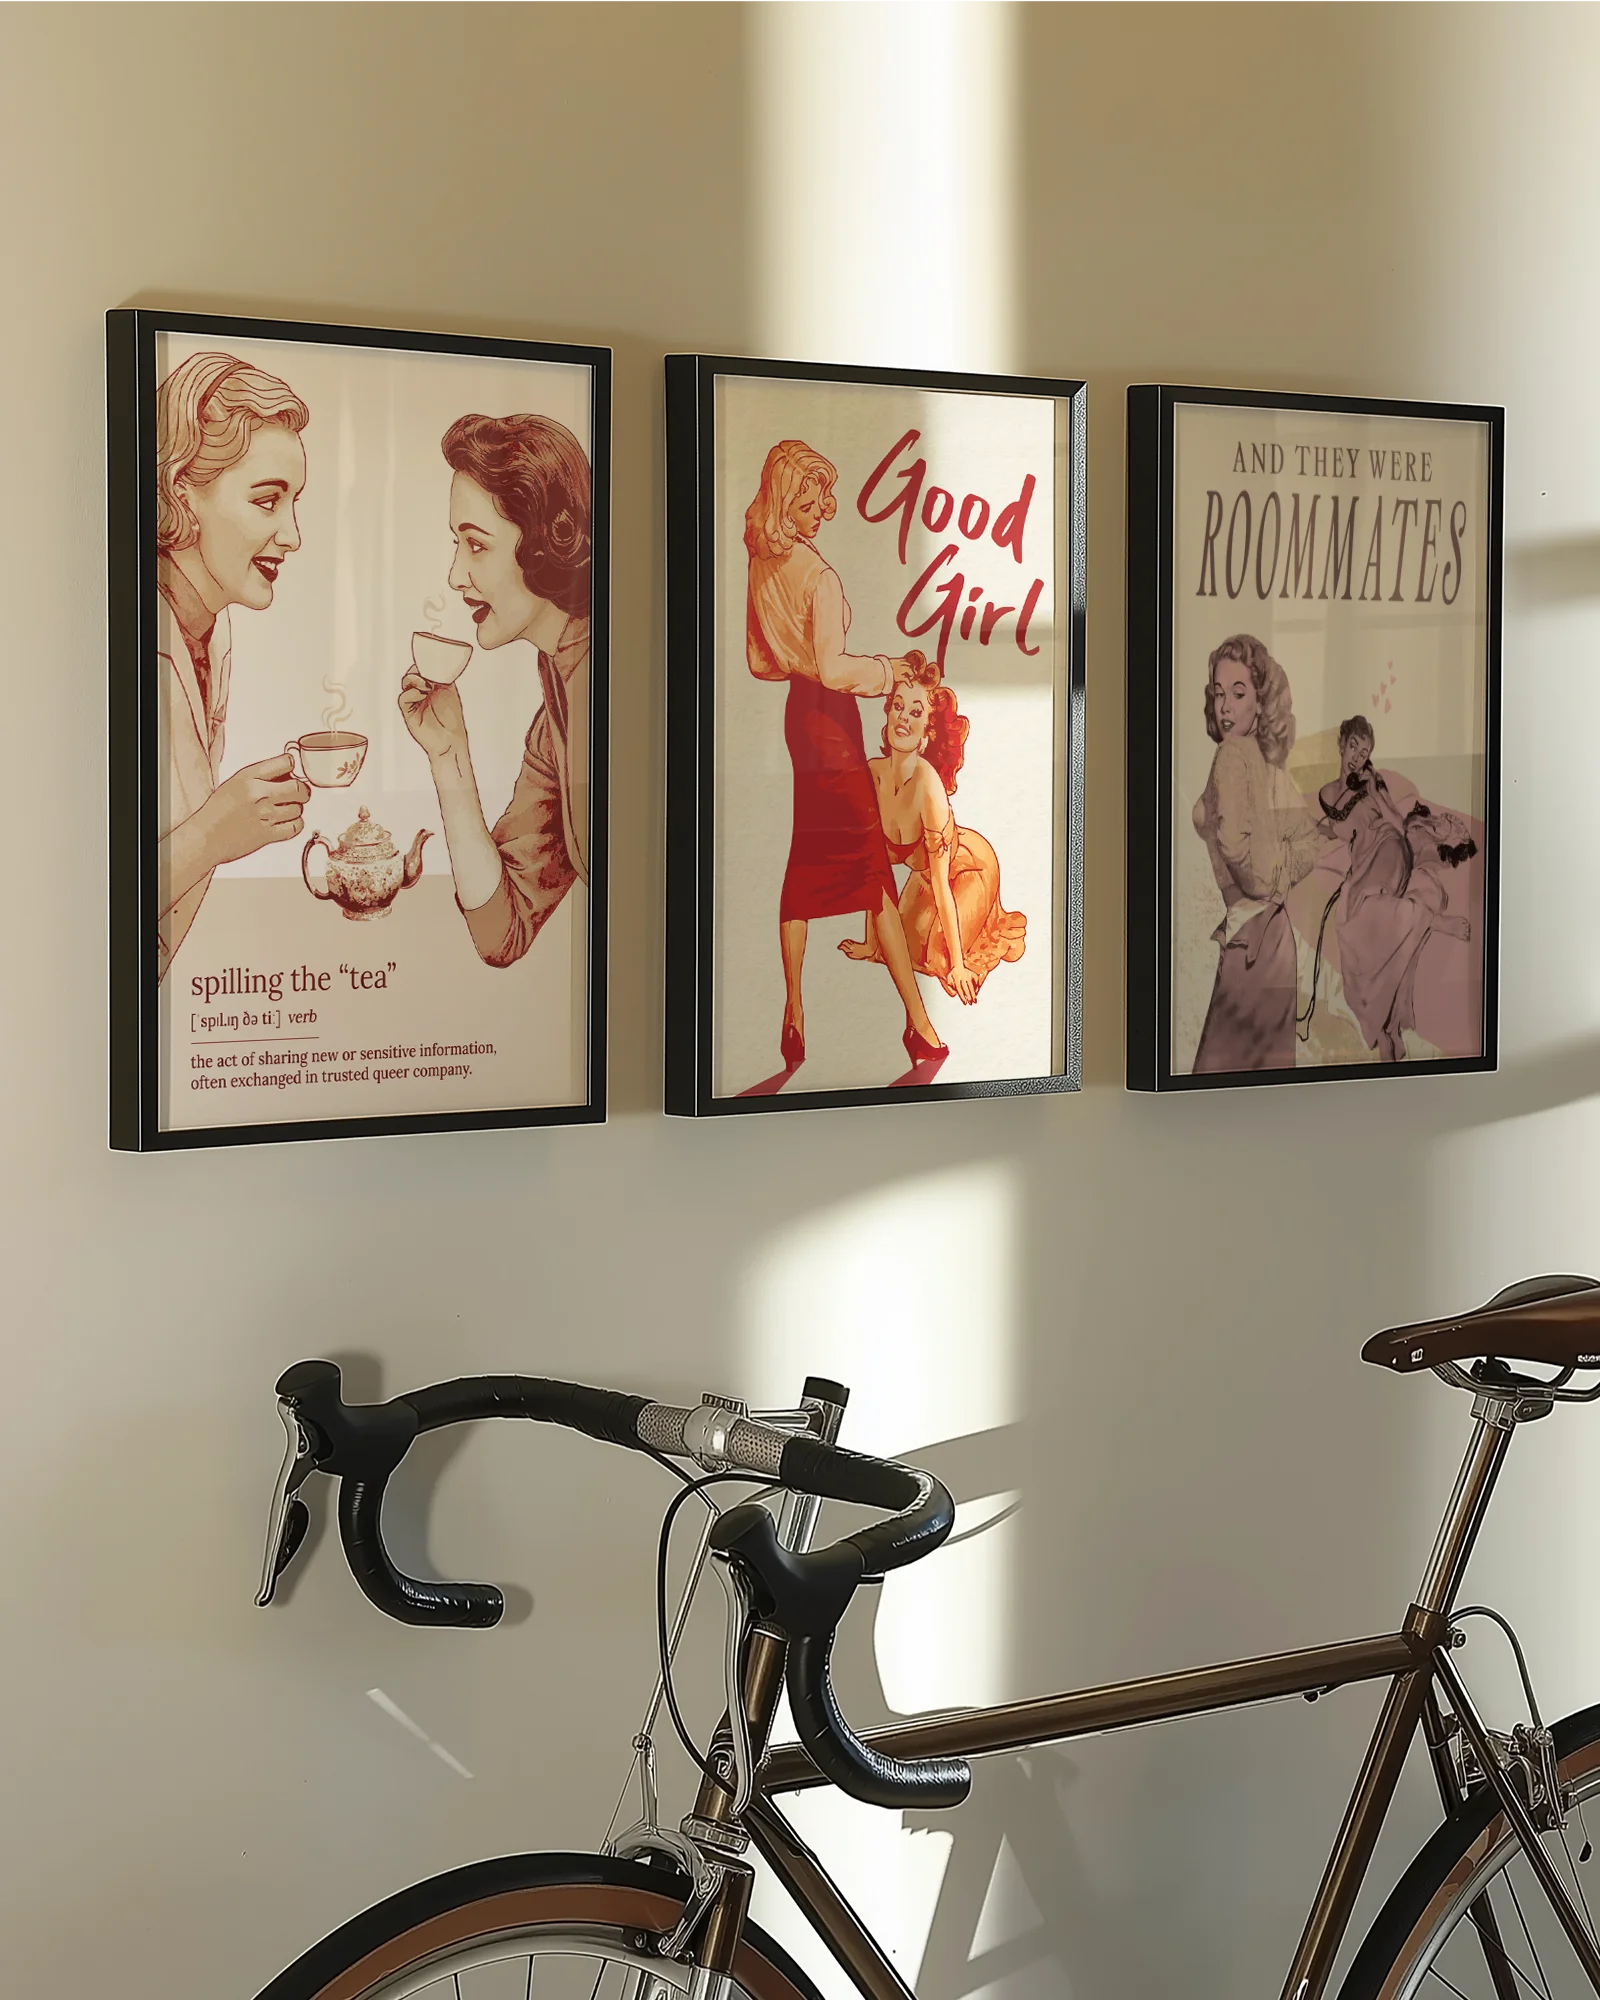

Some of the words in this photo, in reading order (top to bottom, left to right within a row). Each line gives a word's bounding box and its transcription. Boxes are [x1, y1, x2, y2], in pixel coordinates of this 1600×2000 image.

[1232, 441, 1284, 475] AND
[1294, 443, 1360, 479] THEY
[1368, 449, 1433, 483] WERE
[856, 428, 1037, 565] Good
[1195, 489, 1467, 605] ROOMMATES
[896, 543, 1045, 679] Girl
[191, 966, 284, 1004] spilling
[290, 964, 331, 993] the
[287, 1008, 318, 1025] verb
[190, 1053, 213, 1069] the
[216, 1053, 238, 1068] act
[240, 1051, 256, 1067] of
[258, 1050, 308, 1068] sharing
[311, 1050, 339, 1064] new
[341, 1049, 357, 1062] or
[359, 1043, 417, 1061] sensitive
[419, 1040, 498, 1059] information,
[190, 1071, 228, 1091] often
[230, 1068, 302, 1090] exchanged
[305, 1069, 318, 1084] in
[321, 1065, 370, 1083] trusted
[372, 1066, 410, 1085] queer
[413, 1063, 473, 1081] company.
